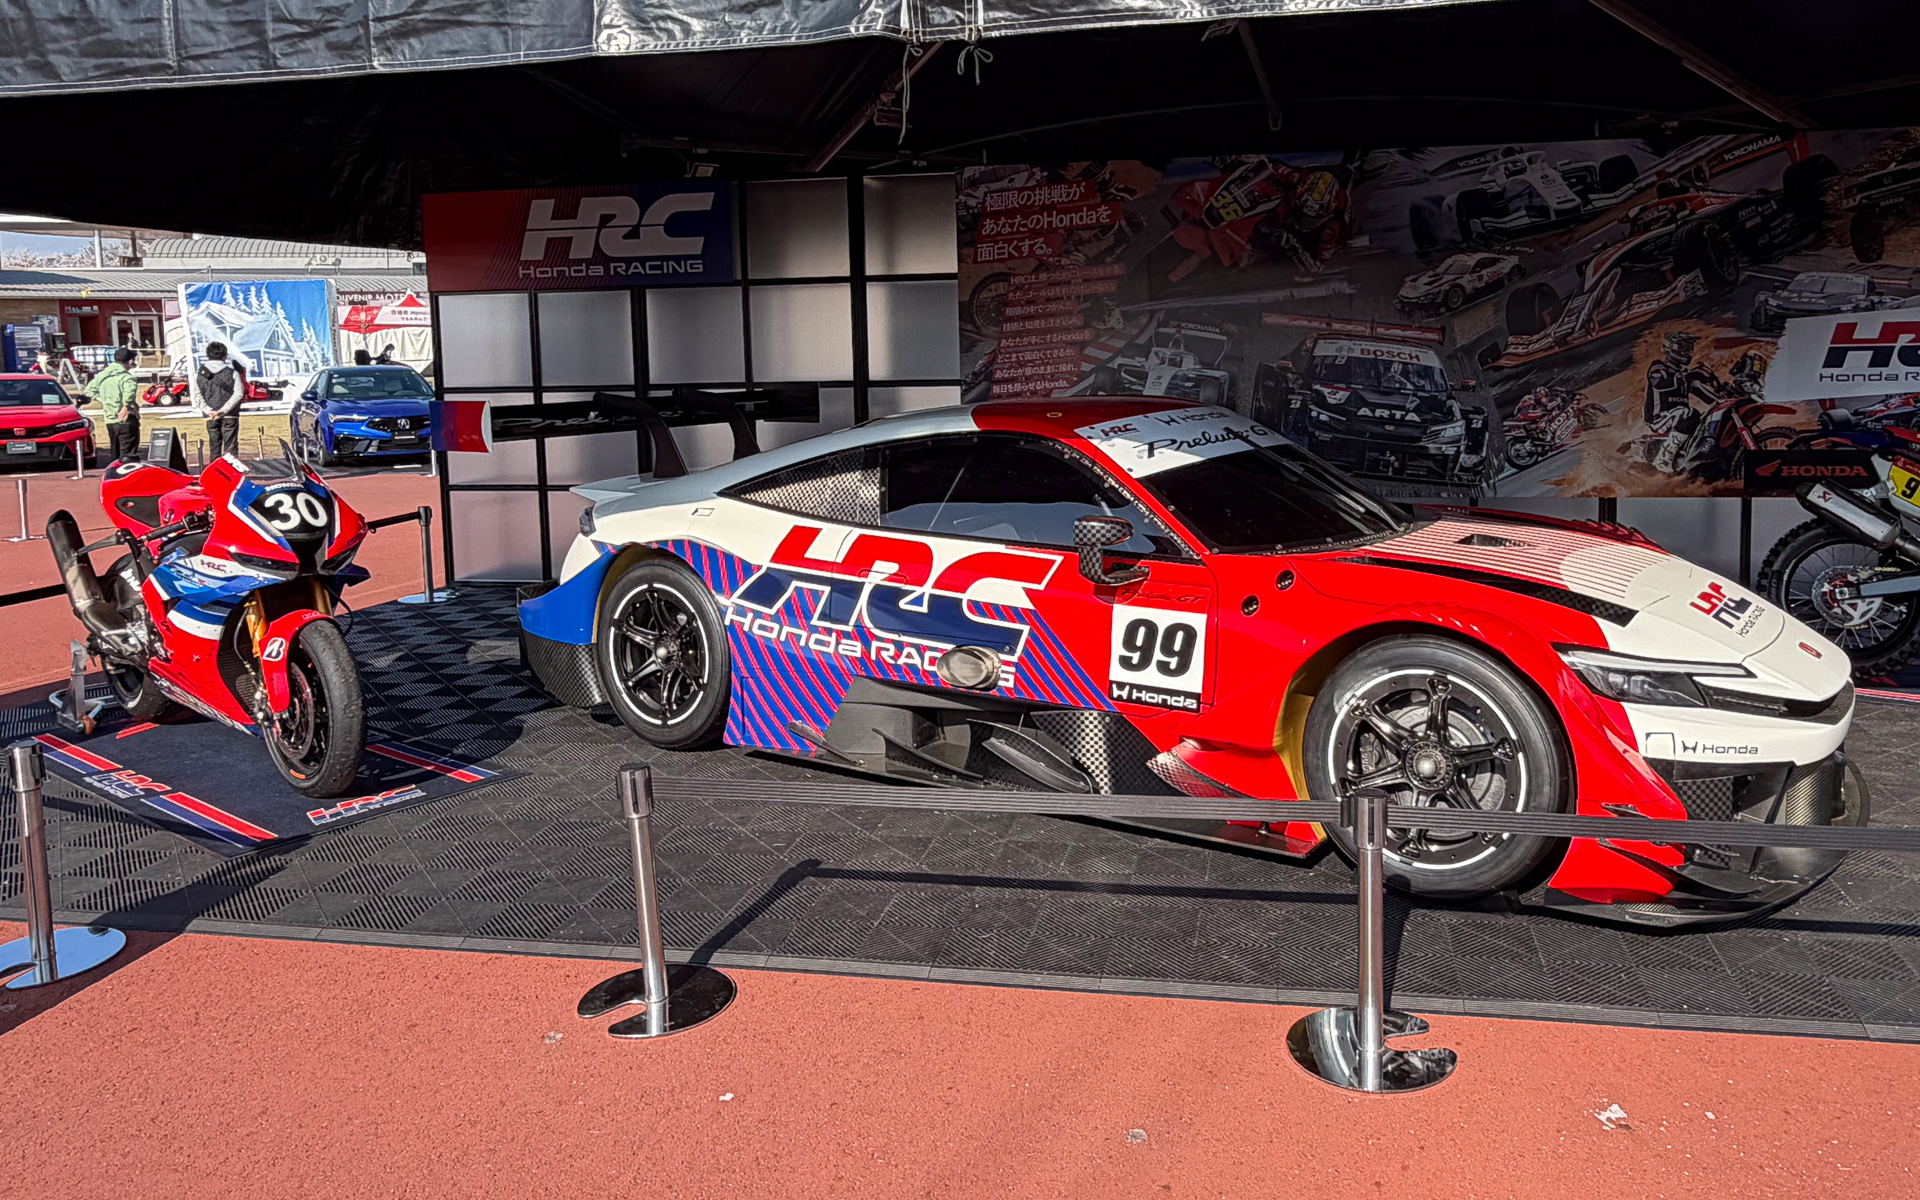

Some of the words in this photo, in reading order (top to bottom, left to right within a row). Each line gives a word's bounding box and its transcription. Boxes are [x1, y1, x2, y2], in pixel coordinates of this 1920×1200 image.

[1723, 135, 1782, 161] YOKOHAMA
[985, 183, 1085, 212] 極限の挑戦が
[520, 192, 715, 261] HRC
[981, 204, 1112, 236] あなたのHondaを
[976, 237, 1054, 262] 面白くする。
[519, 263, 604, 279] Honda
[610, 260, 704, 275] RACING
[1360, 348, 1421, 362] BOSCH
[1819, 371, 1899, 382] Honda
[1179, 411, 1230, 423] Honda
[1356, 407, 1422, 422] ARTA
[1100, 423, 1140, 438] HRC
[1780, 465, 1869, 477] HONDA
[264, 492, 328, 530] 30
[200, 559, 227, 574] HRC
[730, 525, 1063, 661] HRC
[725, 604, 863, 657] Honda
[1118, 617, 1198, 678] 99
[1132, 688, 1197, 709] Honda
[1702, 744, 1759, 755] Honda
